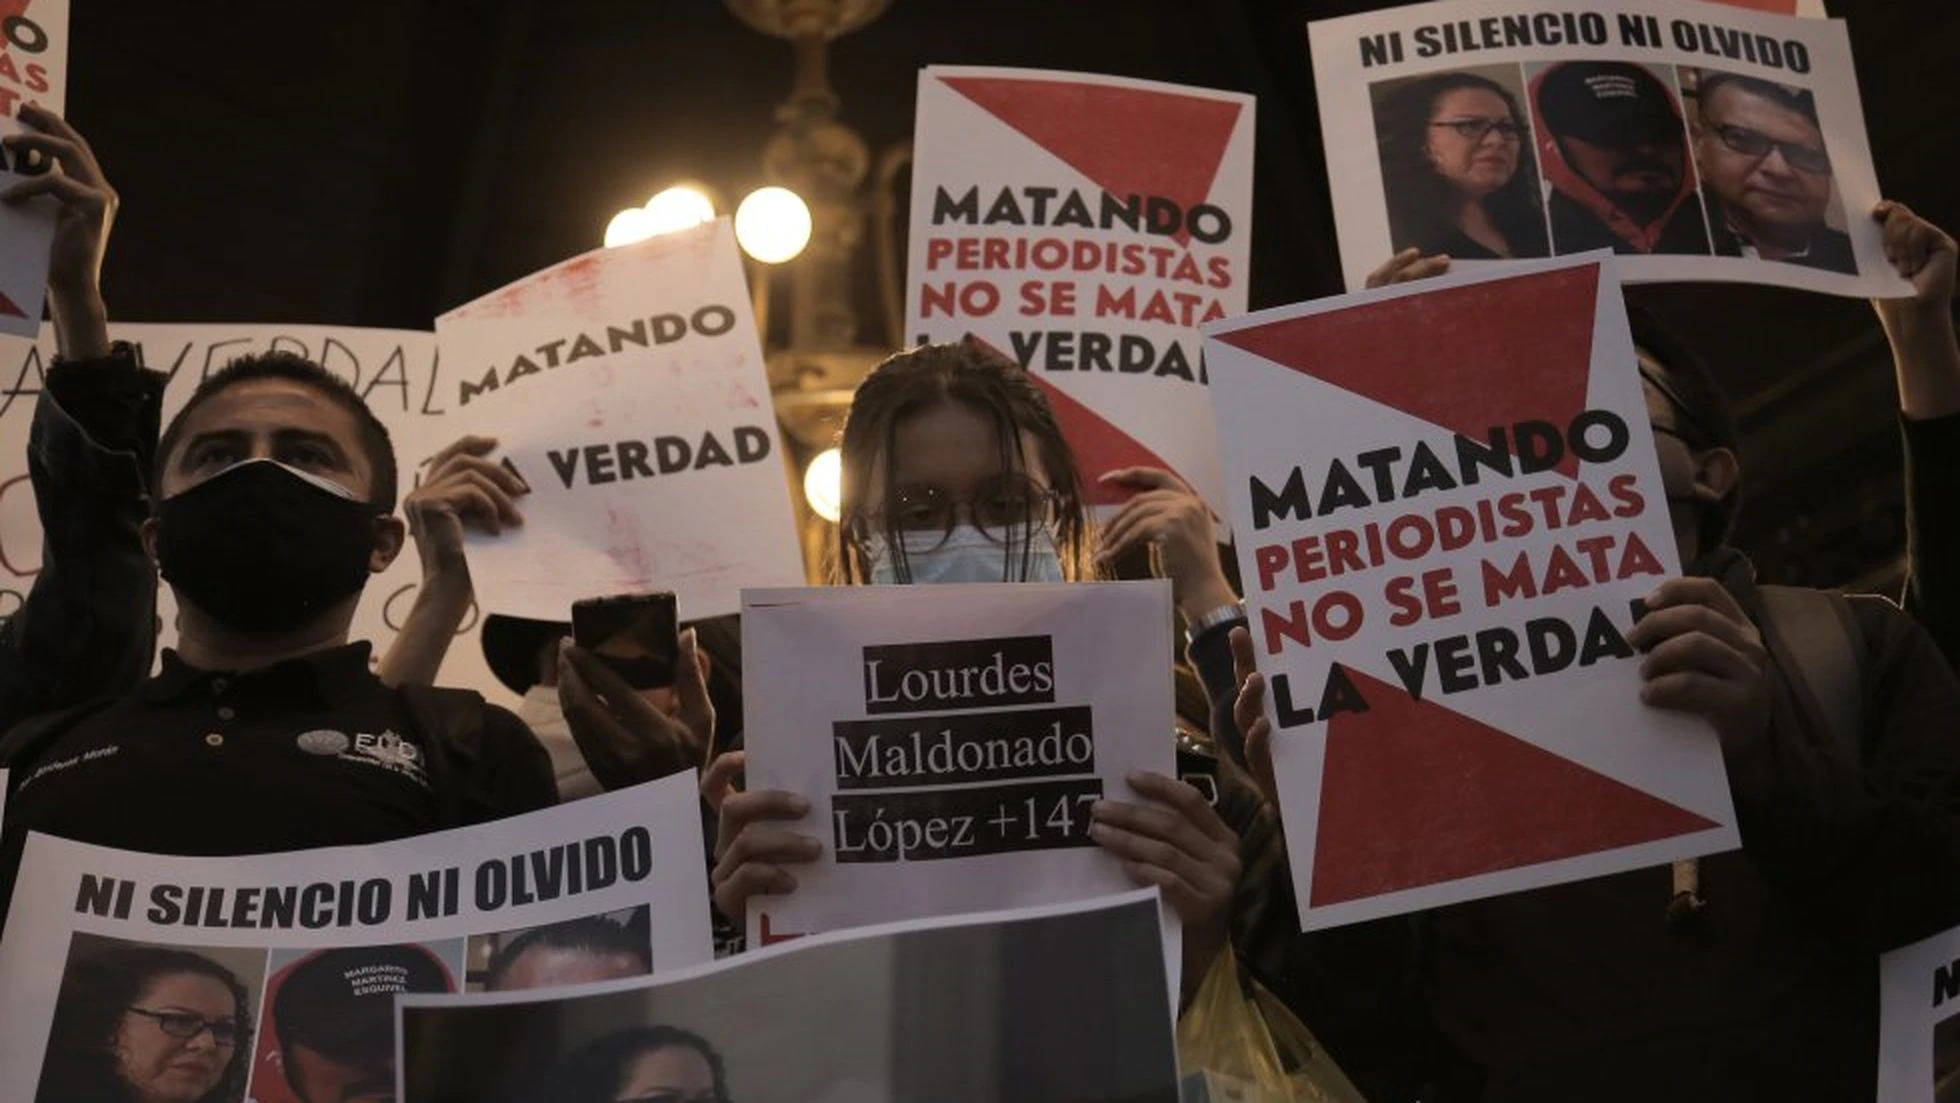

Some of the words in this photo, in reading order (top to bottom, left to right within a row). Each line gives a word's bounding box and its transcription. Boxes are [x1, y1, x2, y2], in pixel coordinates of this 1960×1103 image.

[1359, 31, 1403, 68] NI
[1415, 12, 1608, 58] SILENCIO
[1619, 14, 1662, 49] NI
[1671, 19, 1810, 75] OLVIDO
[932, 185, 1232, 245] MATANDO
[927, 238, 1231, 289] PERIODISTAS
[920, 281, 1000, 318] NO
[1018, 281, 1076, 317] SE
[459, 305, 736, 406] MATANDO
[1009, 331, 1209, 386] VERDA
[547, 426, 772, 490] VERDAD
[1249, 409, 1630, 530] MATANDO
[1255, 474, 1646, 591] PERIODISTAS
[1261, 590, 1364, 655] NO
[1390, 568, 1461, 628] SE
[1480, 531, 1665, 607] MATA
[866, 653, 1053, 704] Lourdes
[1271, 661, 1370, 730] LA
[836, 722, 1093, 779] Maldonado
[835, 808, 976, 860] López
[988, 793, 1101, 840] +147
[75, 873, 136, 920] NI
[147, 878, 392, 930] SILENCIO
[406, 867, 459, 921] NI
[475, 826, 652, 911] OLVIDO
